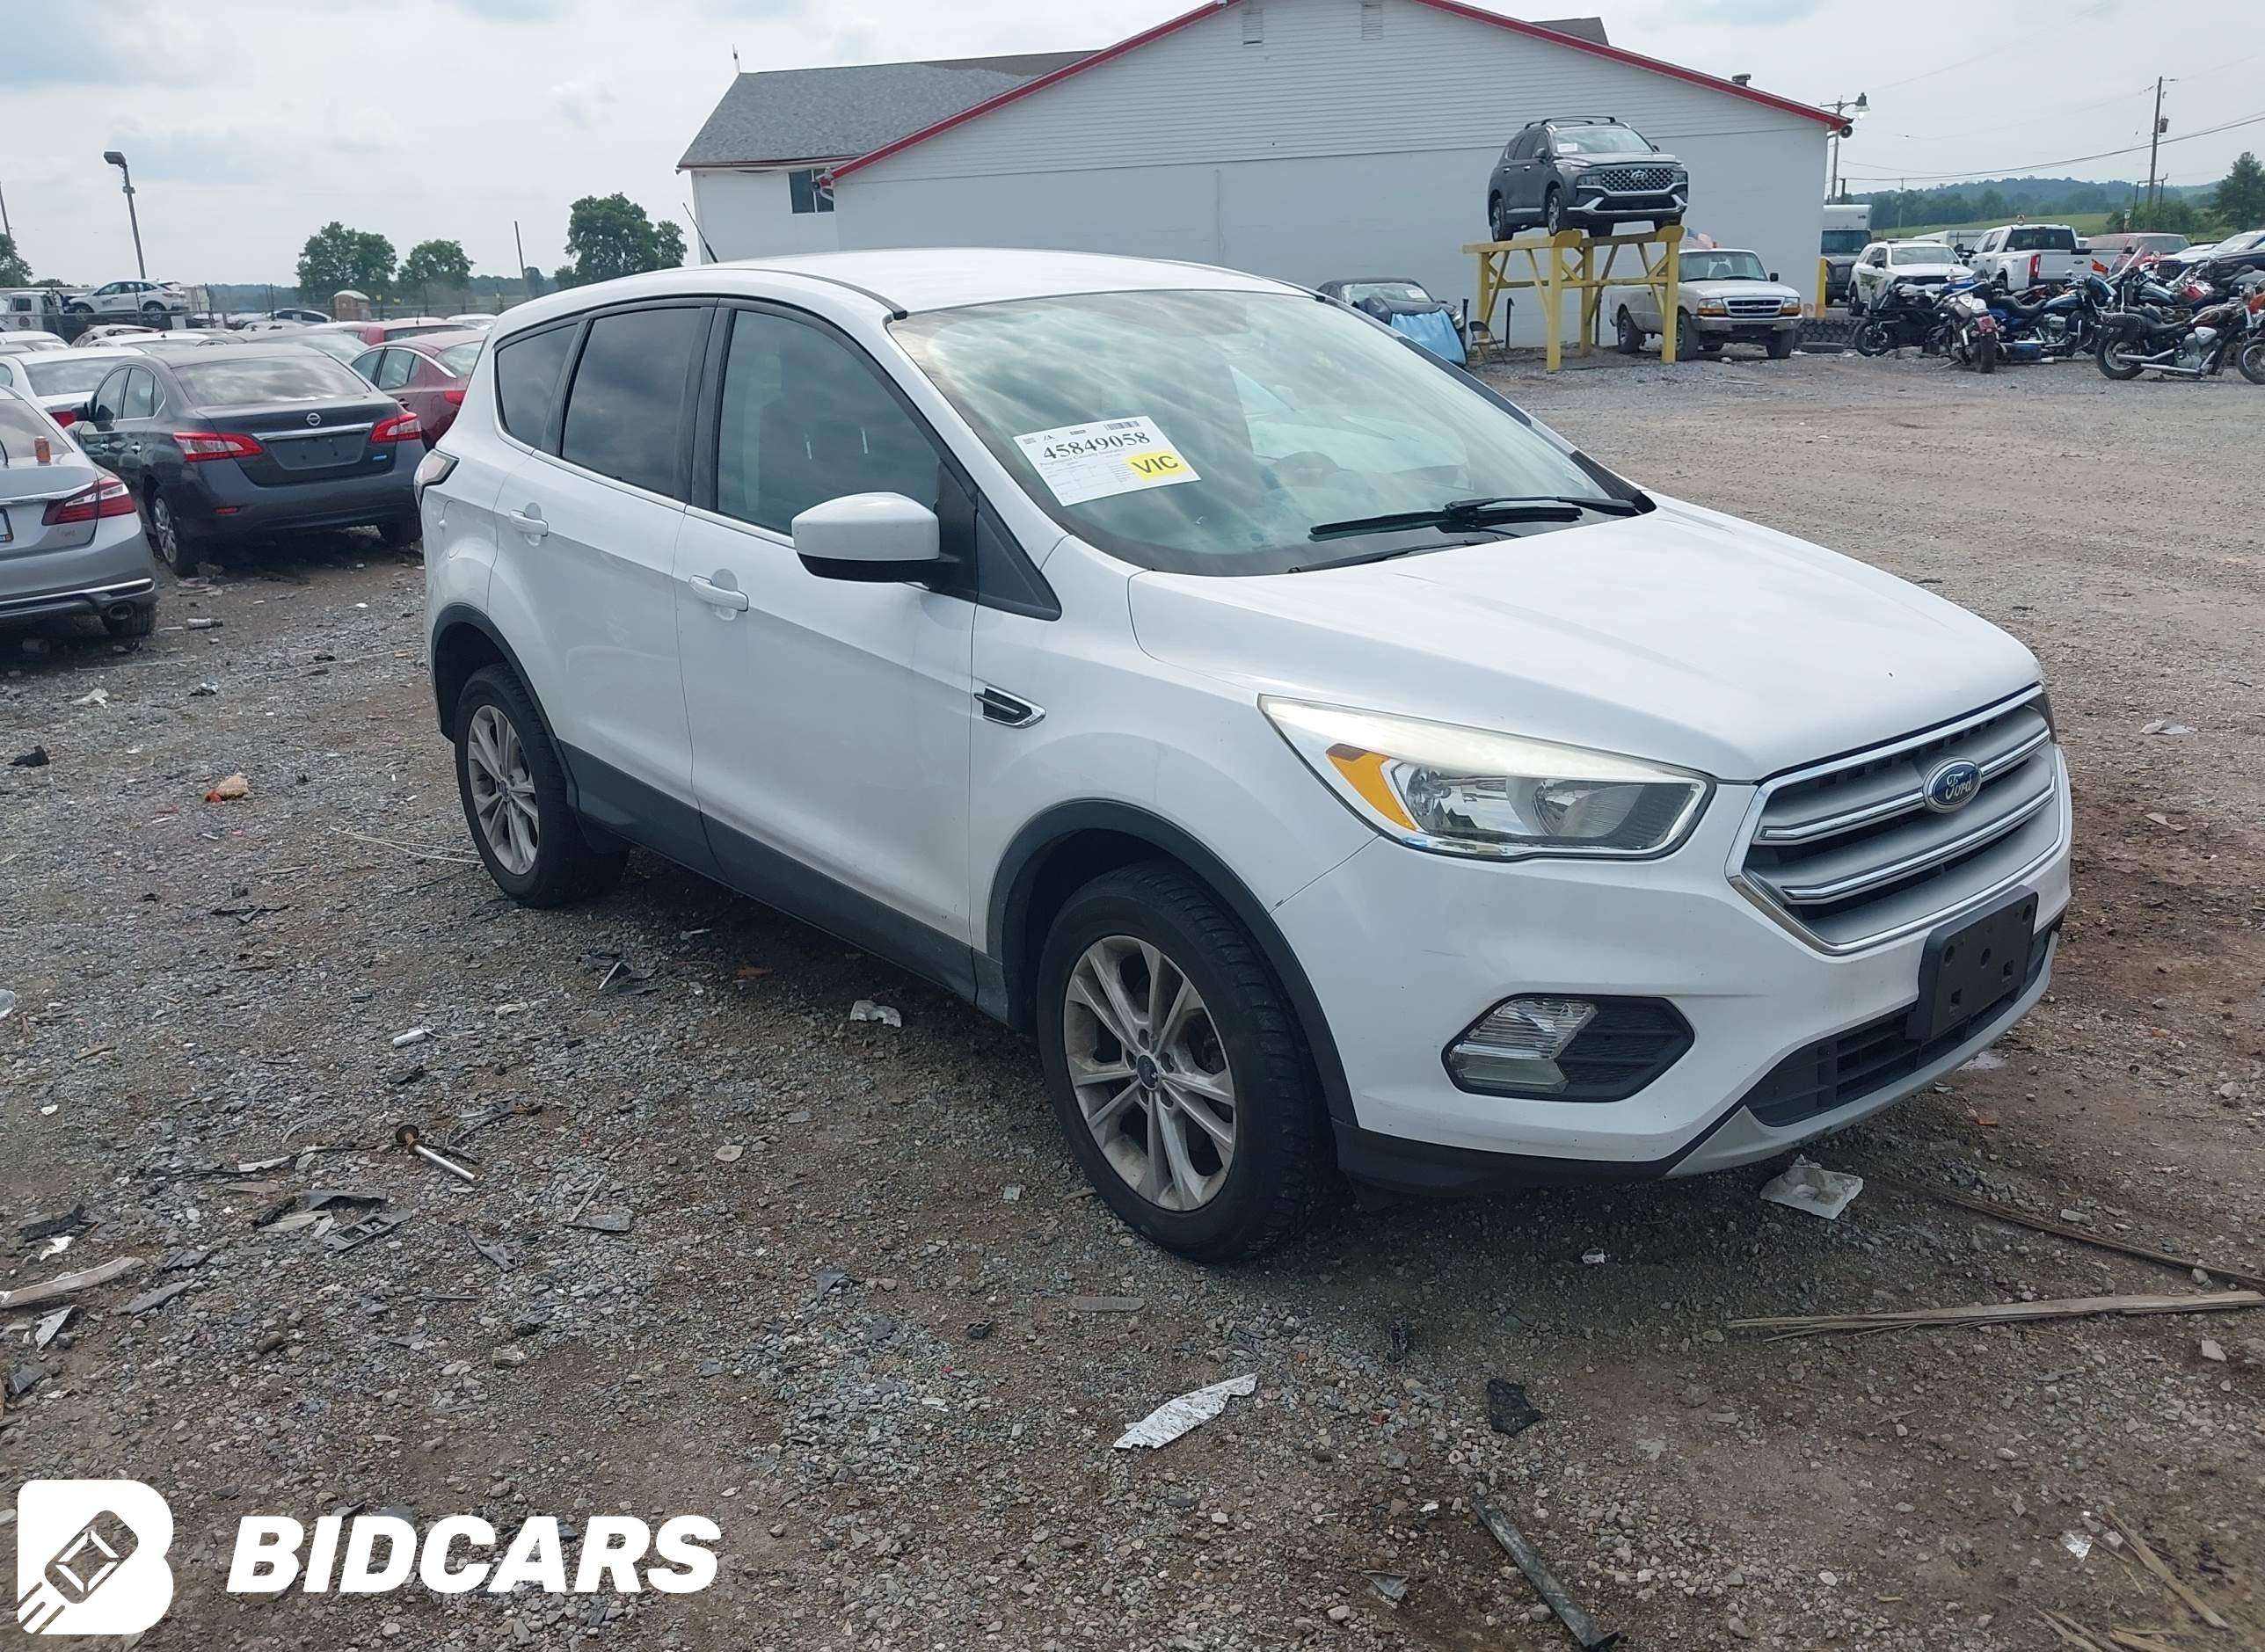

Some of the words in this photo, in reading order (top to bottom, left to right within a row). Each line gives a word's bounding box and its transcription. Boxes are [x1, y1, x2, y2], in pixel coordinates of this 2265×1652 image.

[1044, 432, 1150, 459] 45849058
[1131, 455, 1178, 473] VIC
[1945, 771, 1972, 800] Ford
